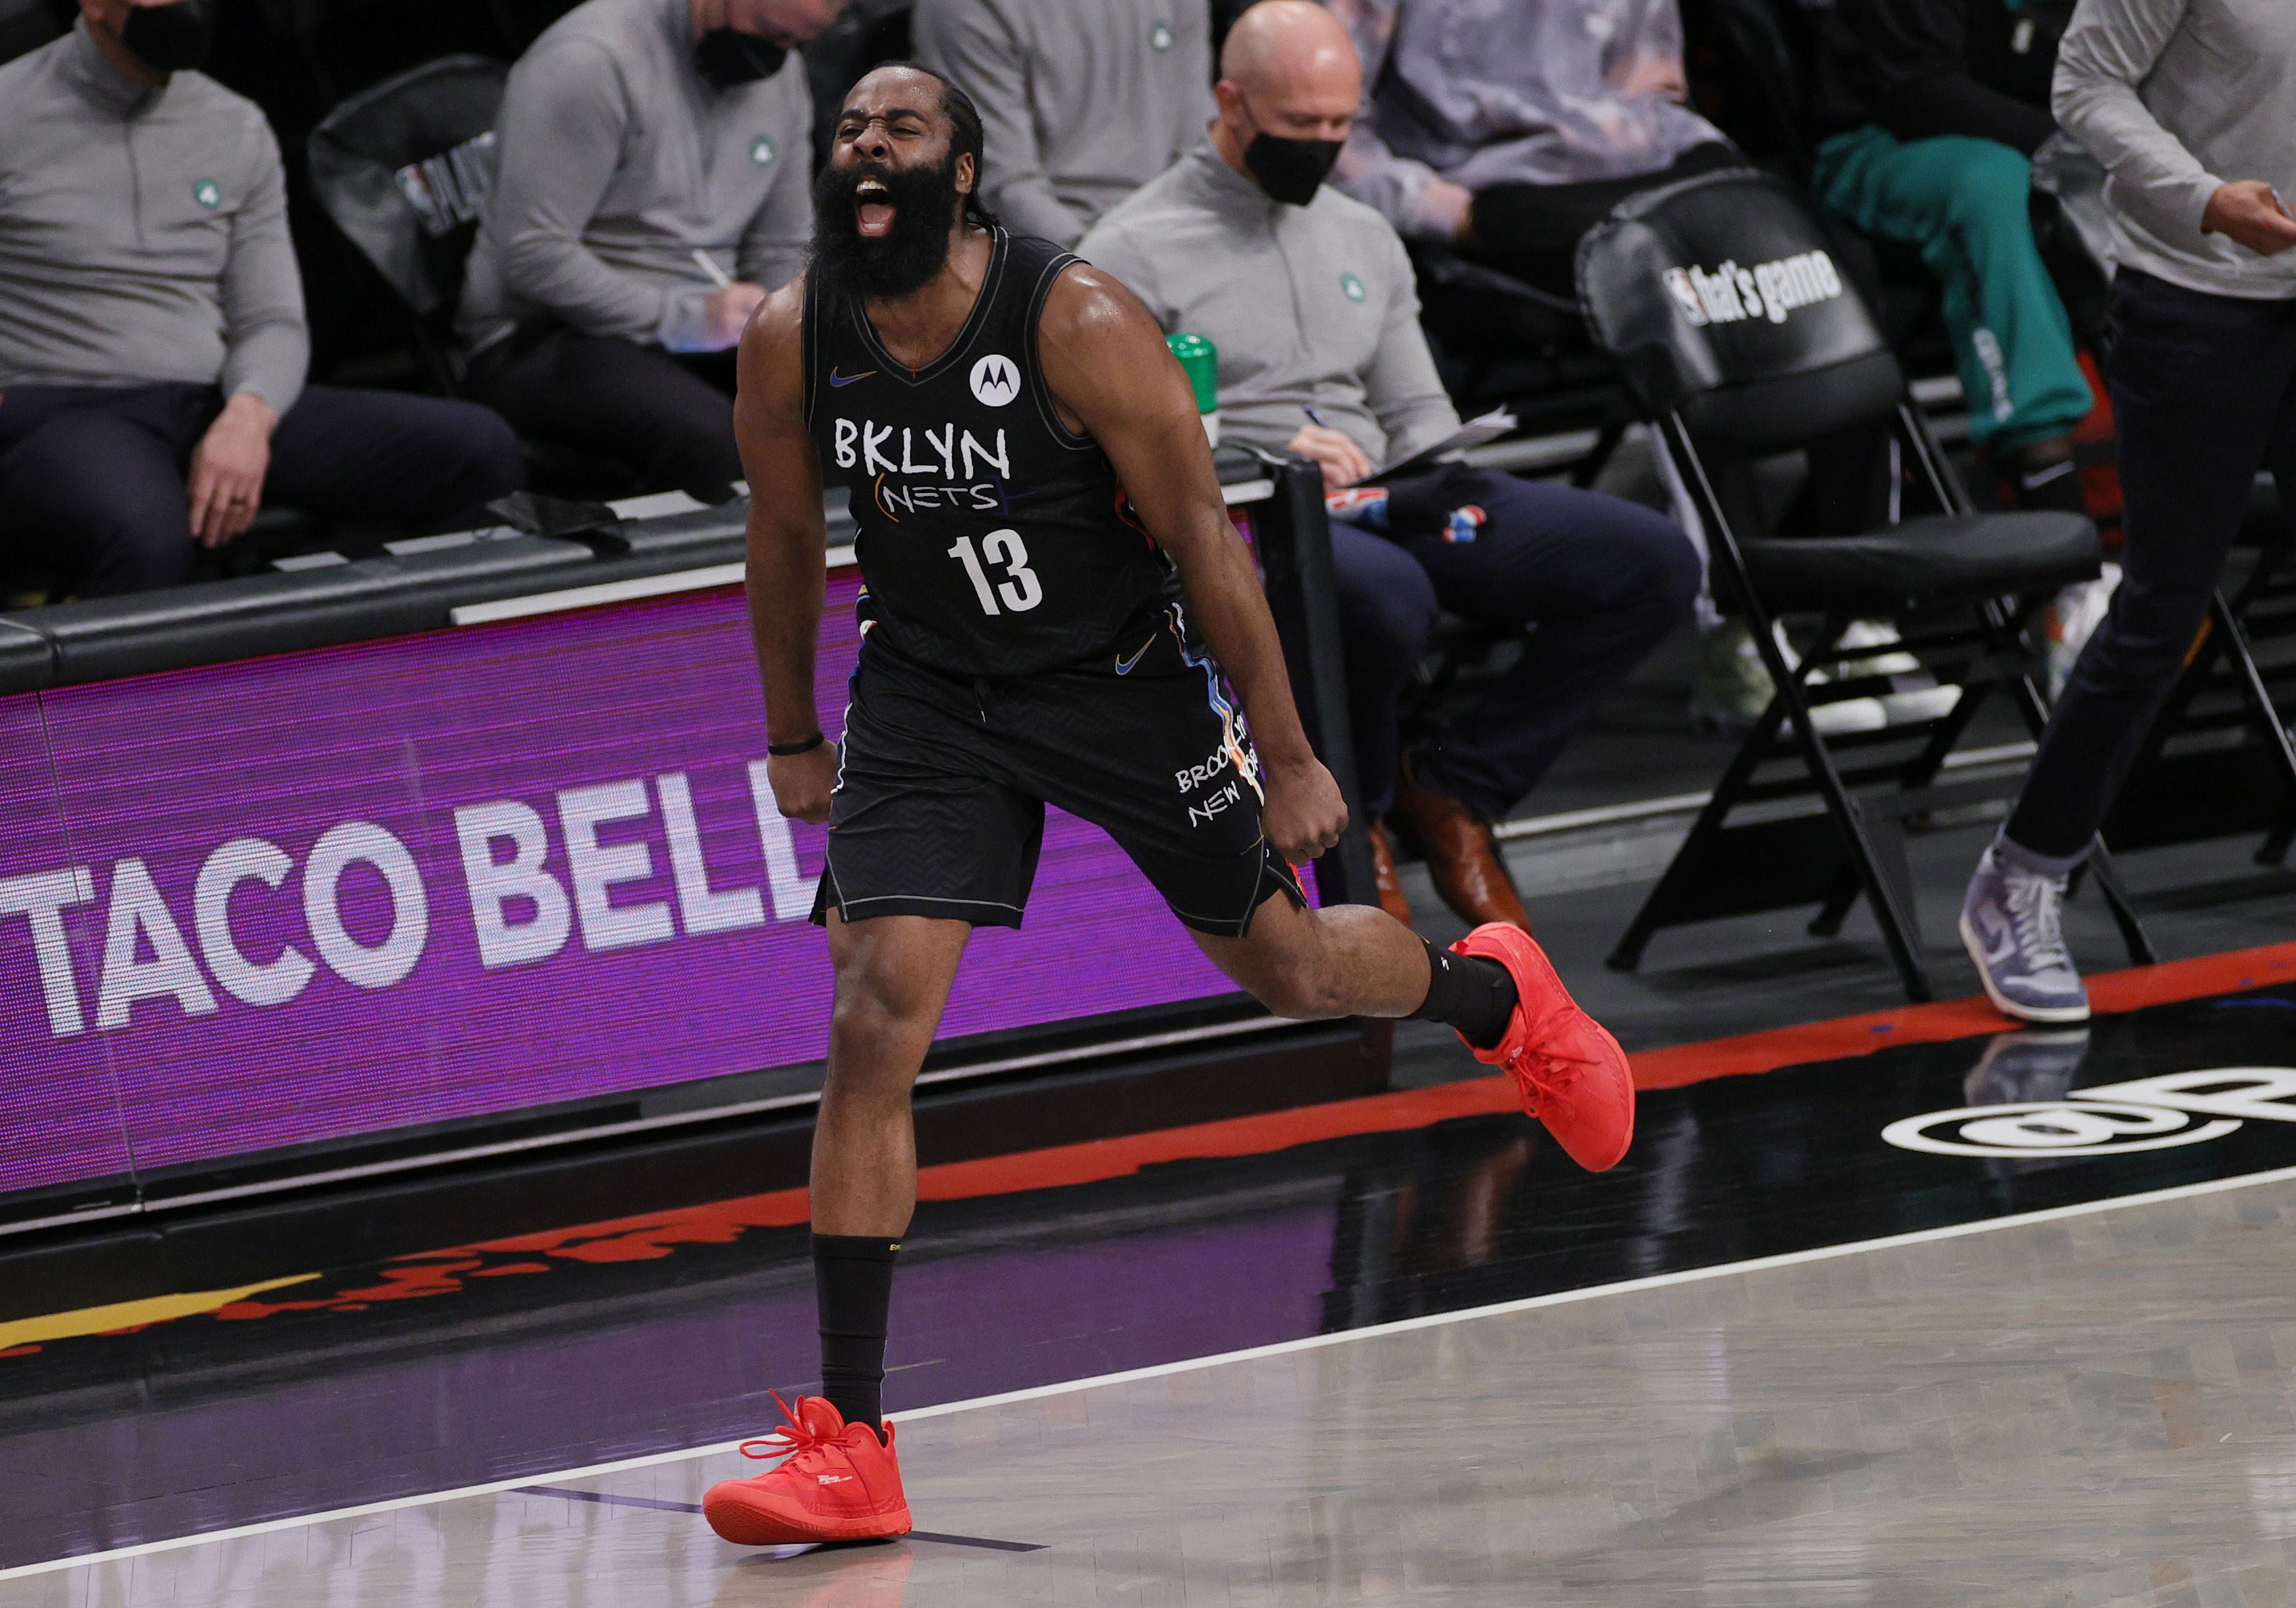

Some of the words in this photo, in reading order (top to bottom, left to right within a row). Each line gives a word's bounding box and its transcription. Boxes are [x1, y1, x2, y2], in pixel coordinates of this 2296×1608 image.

[1754, 249, 1842, 323] game
[835, 418, 1011, 480] BKLYN
[948, 529, 1043, 615] 13
[1188, 781, 1240, 827] NEW
[0, 821, 429, 1037] TACO
[454, 760, 821, 967] BELL
